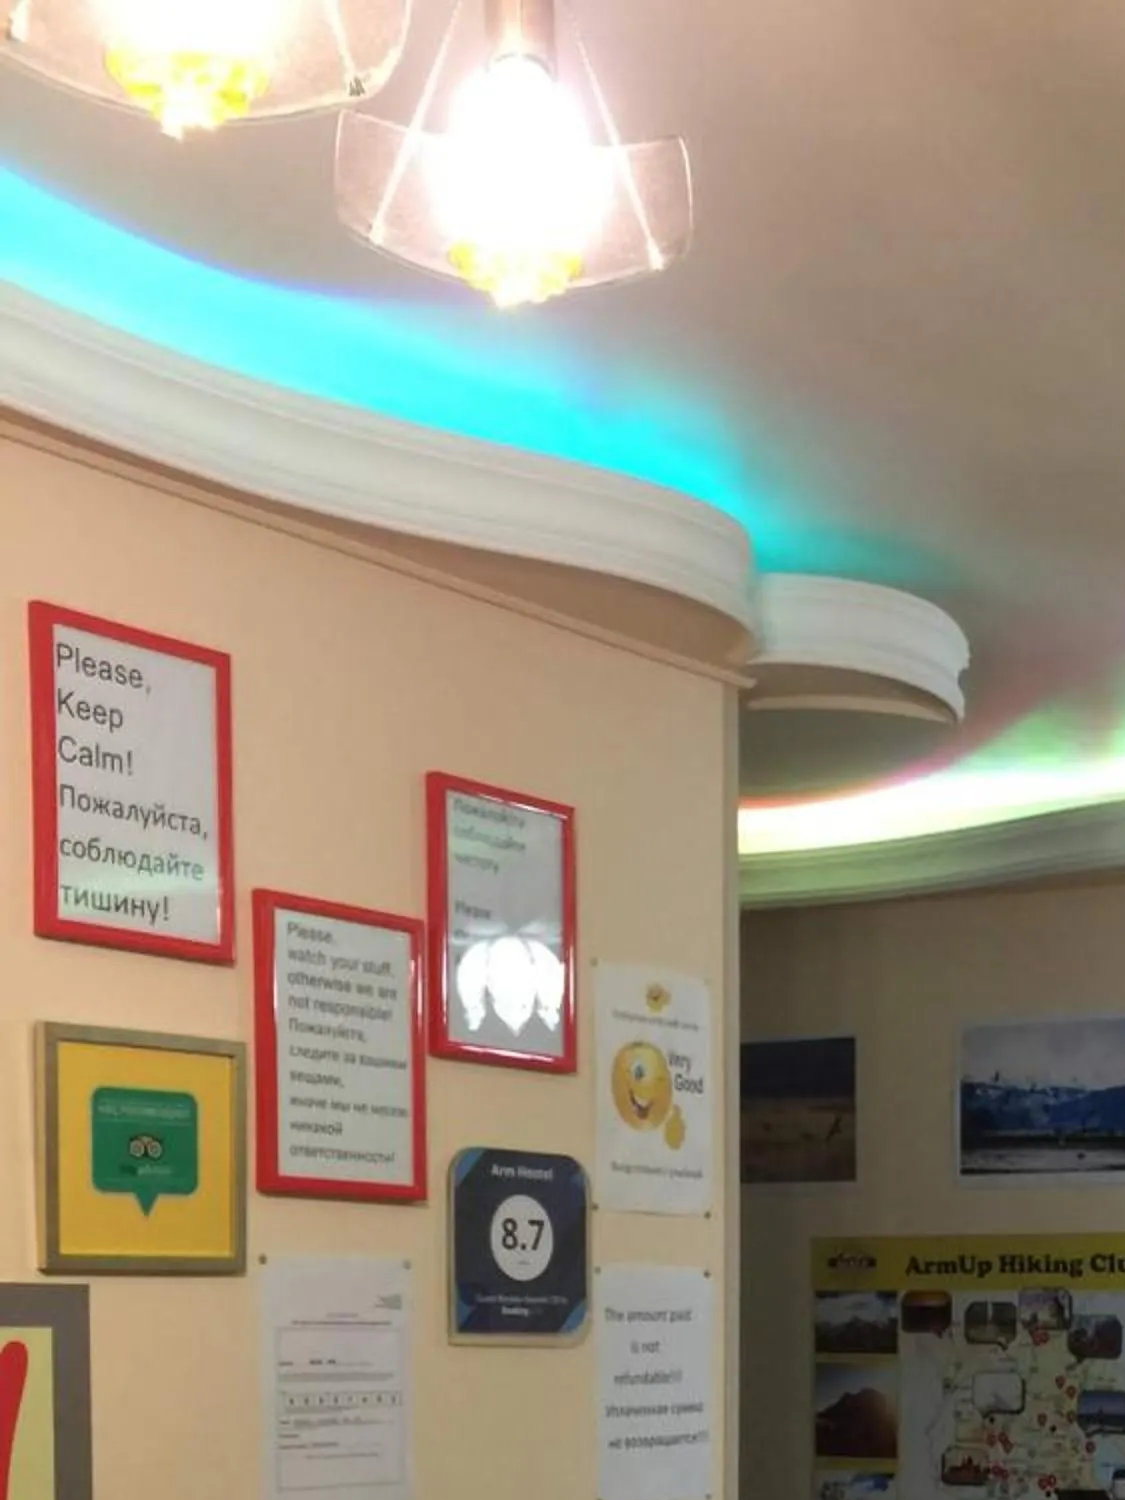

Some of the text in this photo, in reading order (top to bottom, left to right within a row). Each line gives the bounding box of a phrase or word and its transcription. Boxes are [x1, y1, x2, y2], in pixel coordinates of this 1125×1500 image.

[56, 642, 152, 695] Please,
[57, 688, 124, 733] Keep
[58, 735, 134, 776] Calm!
[59, 784, 208, 840] Пожалуйста,
[59, 836, 205, 882] соблюдайте
[61, 883, 170, 925] тишину!
[674, 1072, 705, 1095] Good
[501, 1217, 545, 1251] 8.7
[905, 1254, 993, 1278] ArmUp
[999, 1253, 1084, 1278] Hiking
